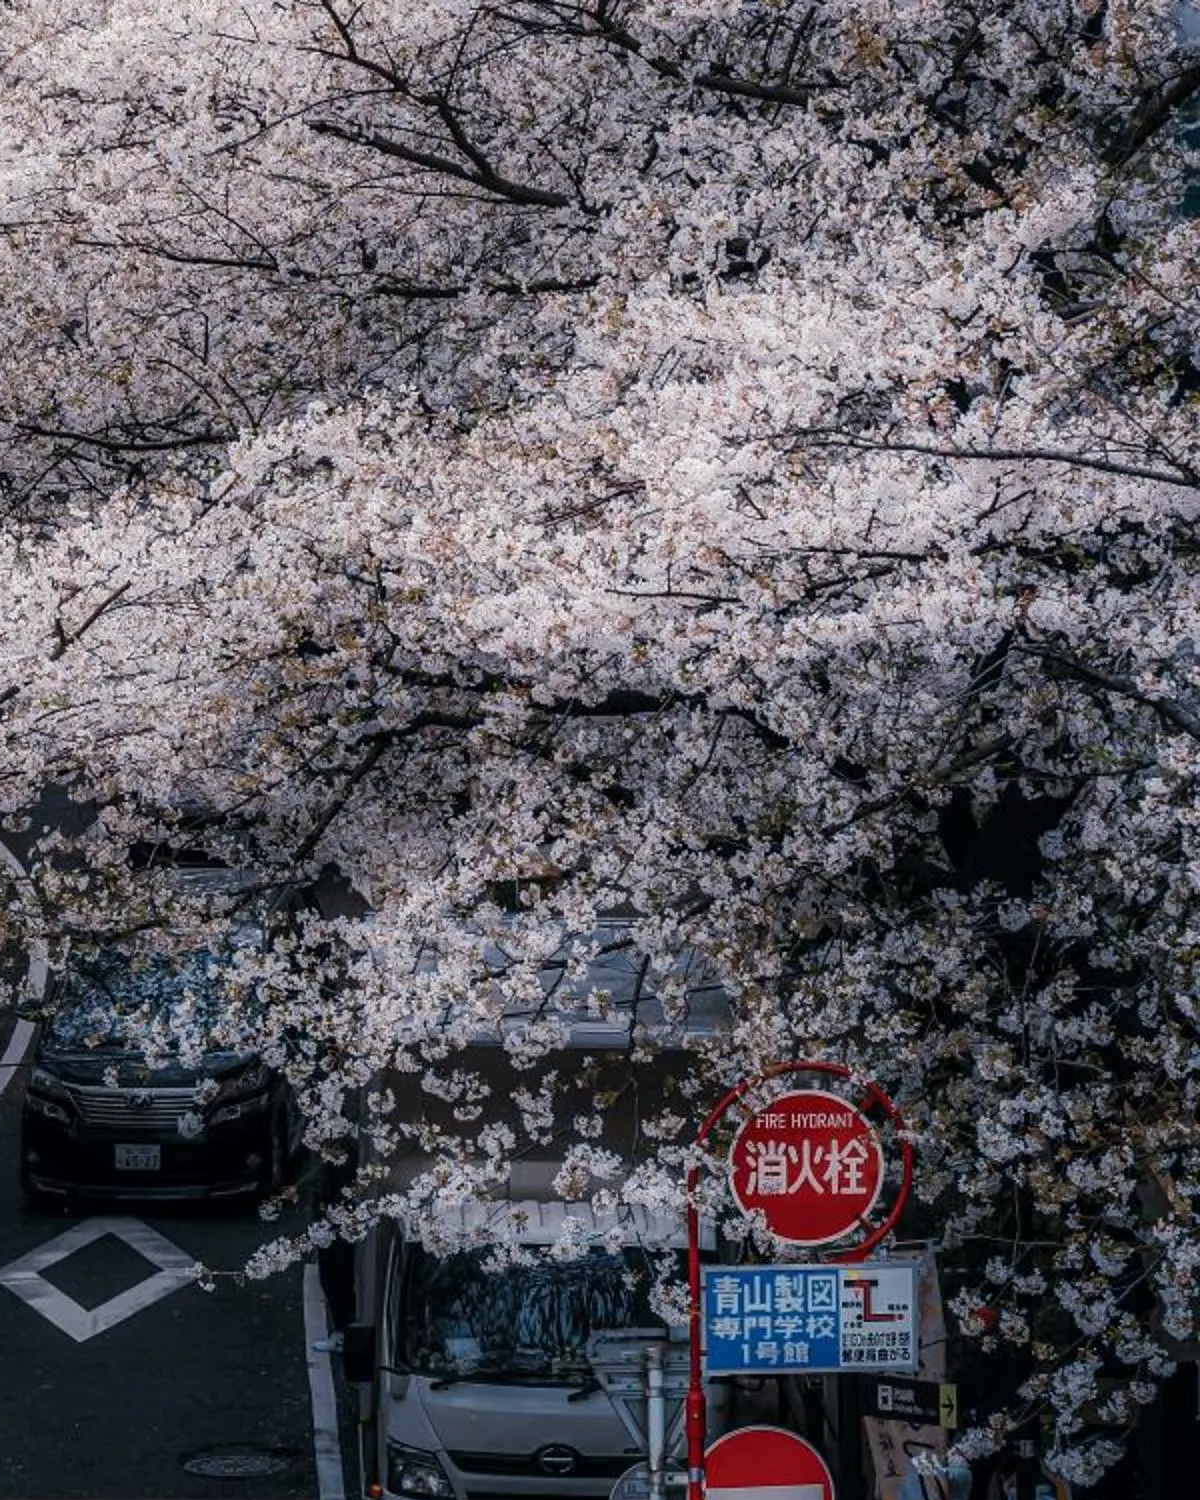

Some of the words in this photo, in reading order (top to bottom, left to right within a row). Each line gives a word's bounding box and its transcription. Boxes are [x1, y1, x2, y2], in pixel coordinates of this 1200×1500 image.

[756, 1113, 787, 1129] FIRE
[791, 1113, 853, 1129] HYDRANT
[745, 1138, 869, 1196] 消火栓
[711, 1273, 837, 1314] 青山製図
[711, 1314, 837, 1341] 専門学校
[740, 1341, 810, 1366] 1号館
